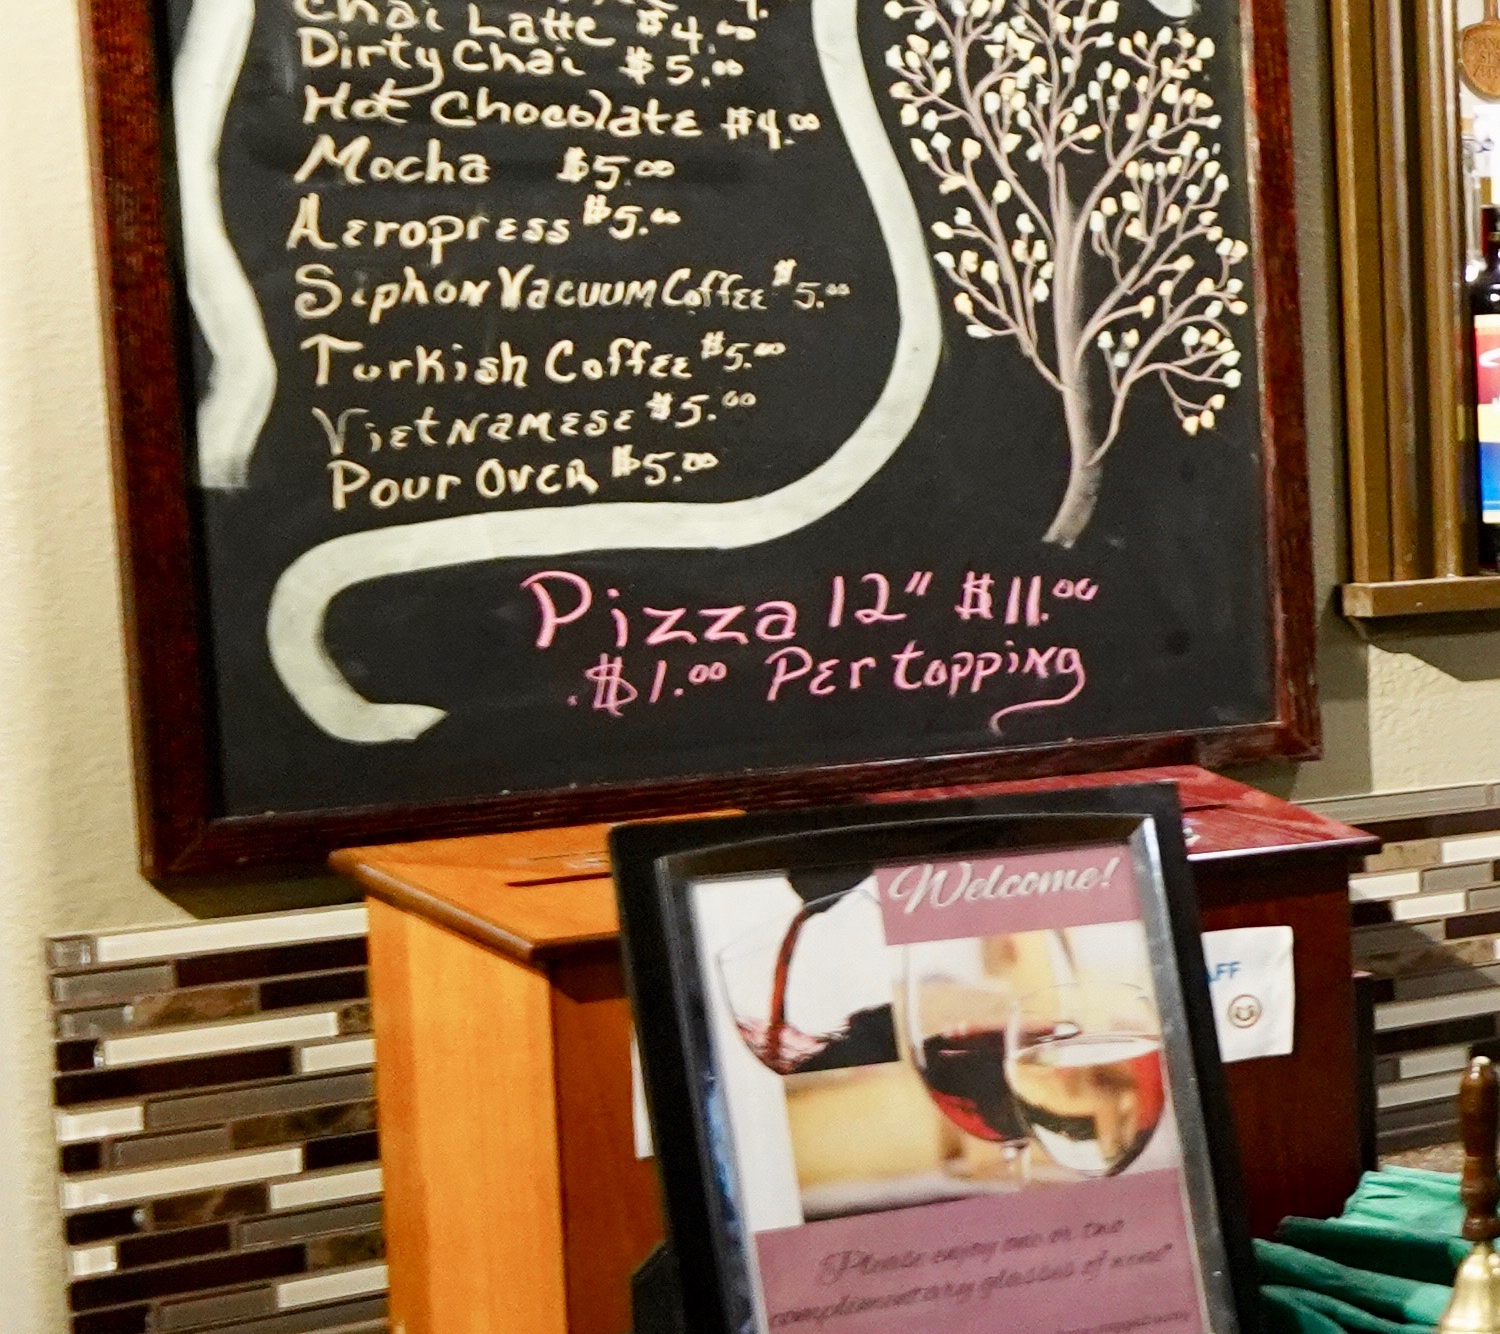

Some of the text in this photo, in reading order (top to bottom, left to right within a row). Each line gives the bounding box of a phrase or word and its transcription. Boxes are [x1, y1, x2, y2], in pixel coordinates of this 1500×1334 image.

[468, 4, 615, 46] Latte
[298, 27, 445, 97] Dirty
[452, 41, 586, 77] Chai
[303, 78, 409, 124] Hot
[431, 88, 703, 138] Chocolate
[293, 134, 490, 186] Mocha
[287, 192, 570, 265] Aeropress
[294, 262, 489, 323] Siphon
[498, 264, 655, 310] Vacuum
[660, 266, 767, 313] Coffee
[301, 334, 528, 387] Turkish
[544, 338, 692, 382] Coffee
[326, 459, 460, 510] Pour
[521, 571, 798, 648] Pizza
[954, 572, 1098, 628] $11.00
[767, 645, 877, 702] Per
[889, 856, 1120, 915] Welcome!
